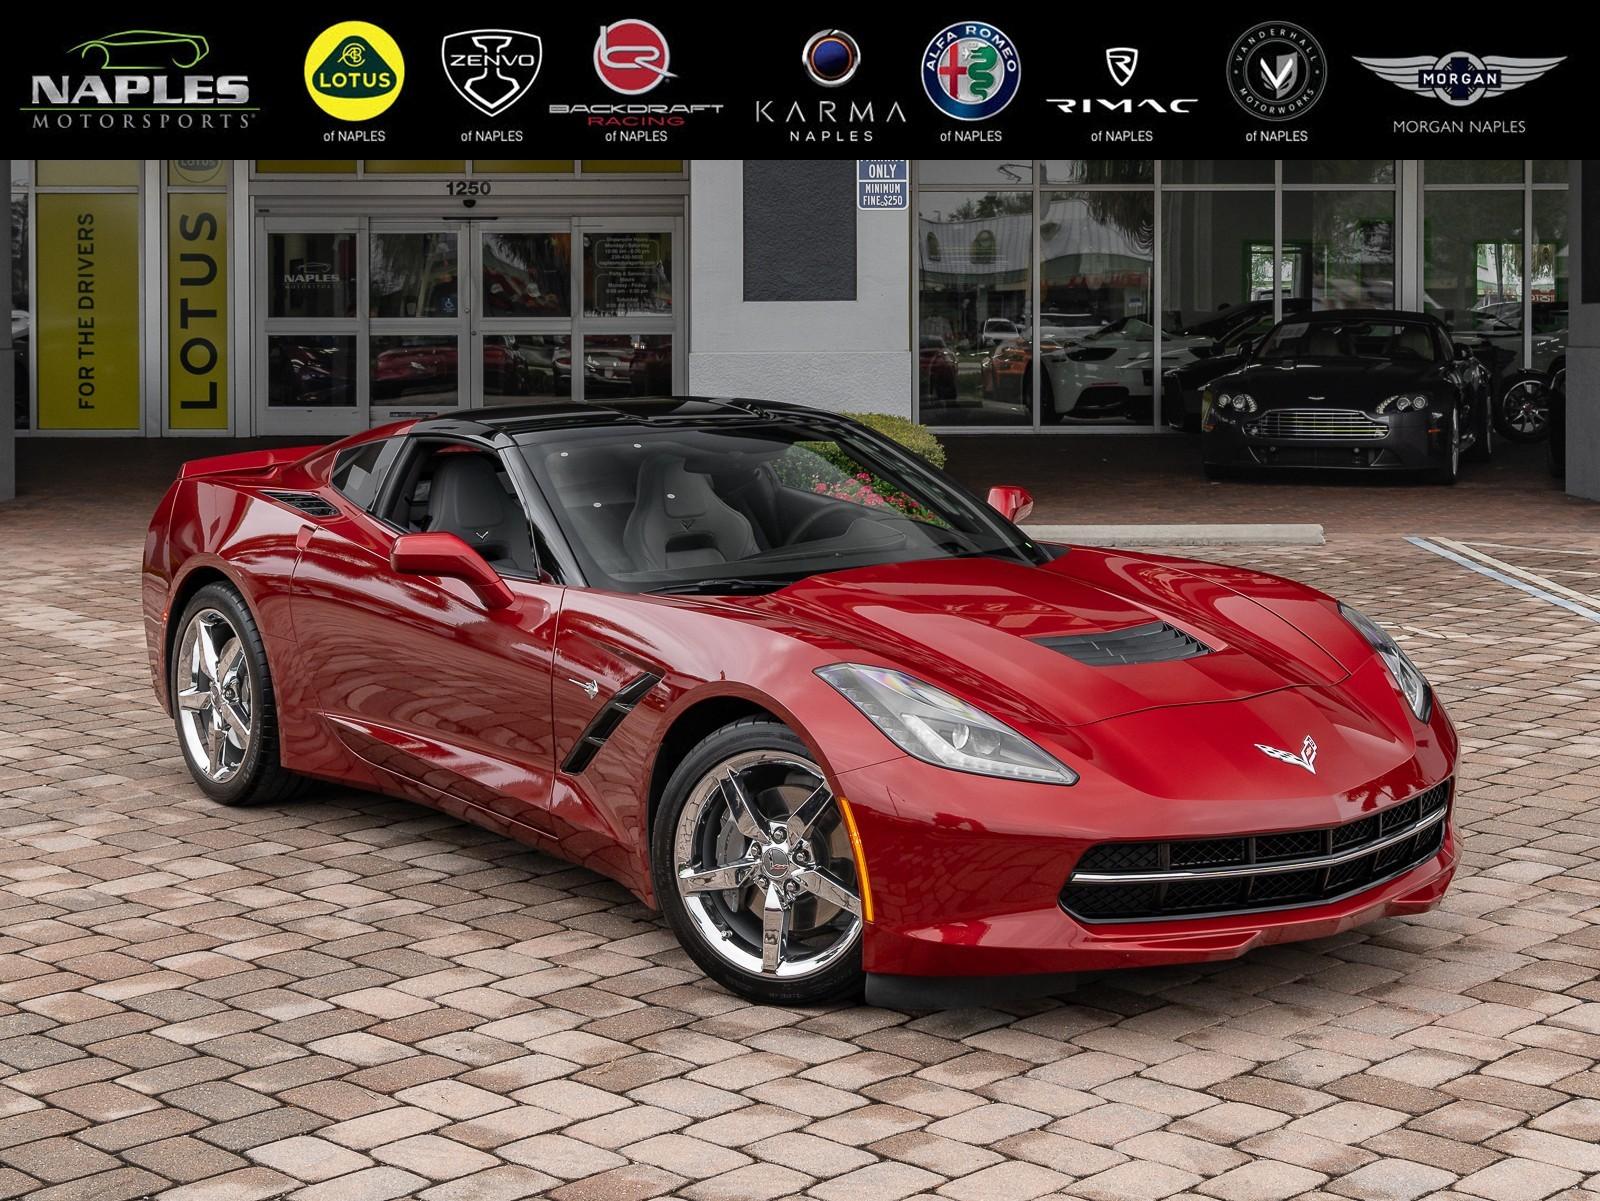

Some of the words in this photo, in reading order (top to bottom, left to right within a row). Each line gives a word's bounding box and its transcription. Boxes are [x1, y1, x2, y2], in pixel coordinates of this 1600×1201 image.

[869, 164, 897, 178] ONLY
[446, 181, 491, 196] 1250
[865, 183, 901, 194] MINIMUM
[863, 195, 881, 206] FINE
[883, 195, 903, 206] $250
[77, 212, 95, 311] DRIVERS
[284, 274, 340, 283] NAPLES
[179, 211, 218, 410] LOTUS
[77, 316, 95, 360] THE
[77, 366, 95, 409] FOR
